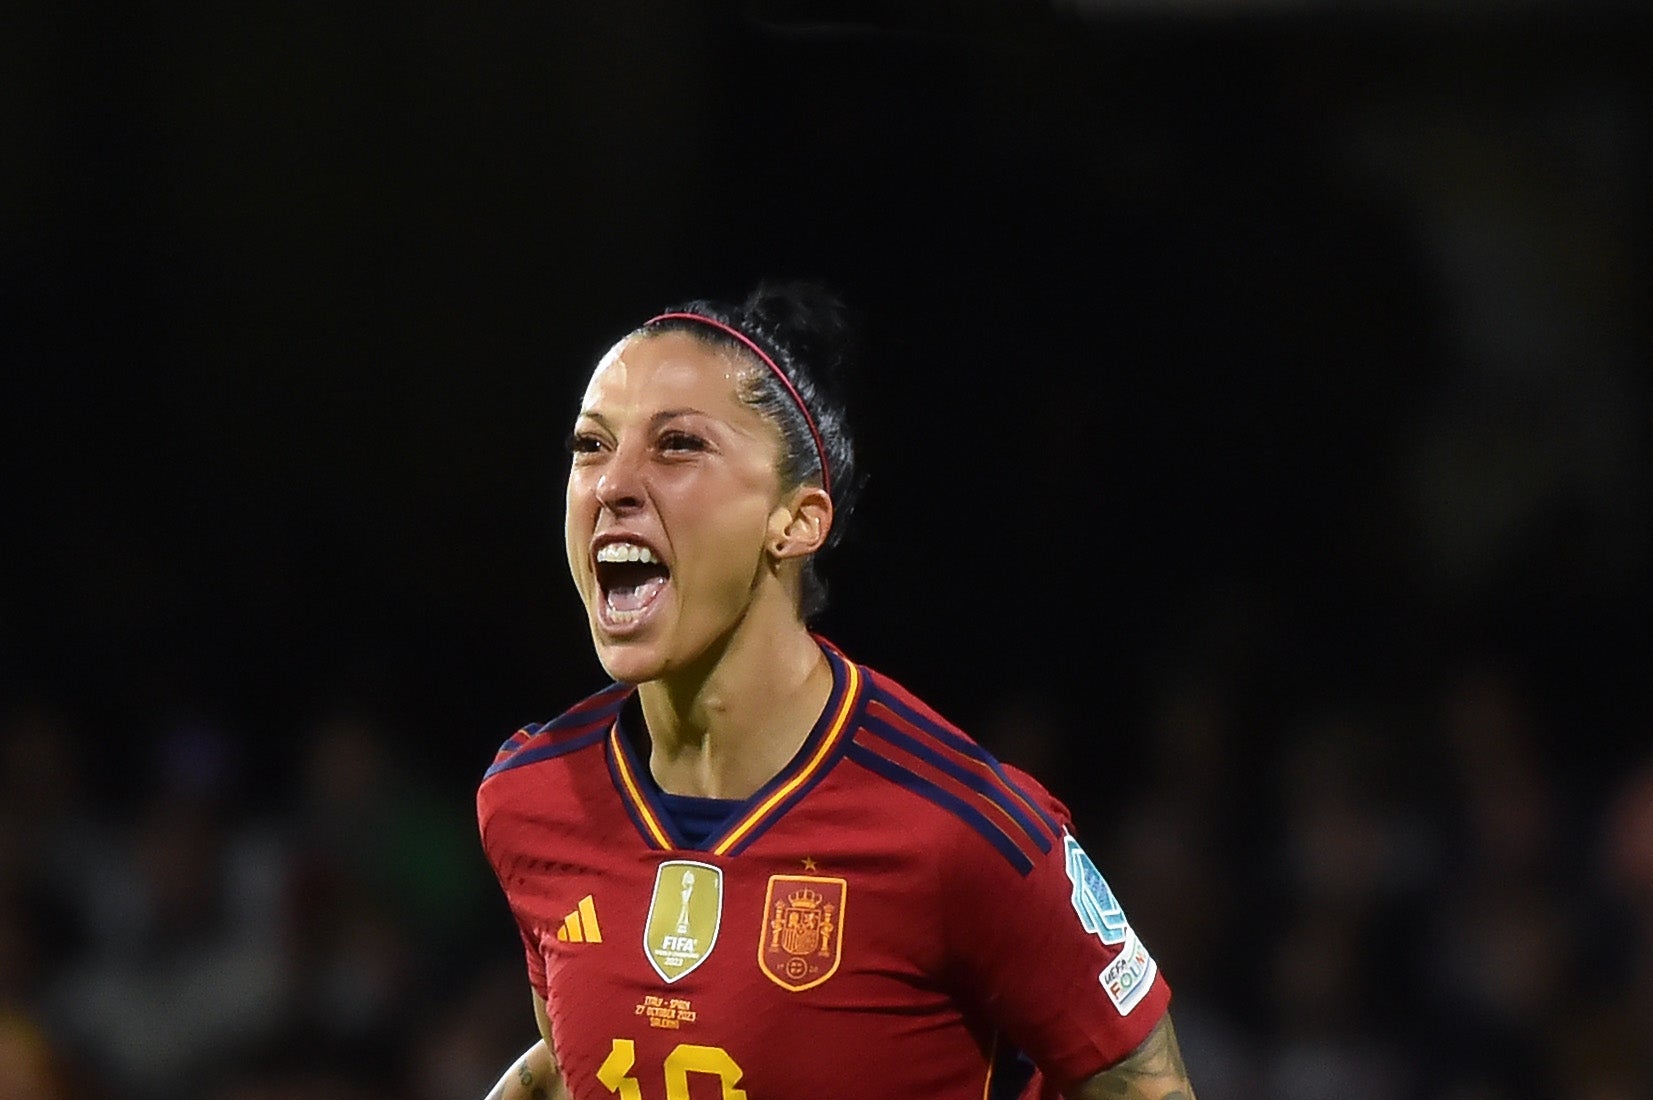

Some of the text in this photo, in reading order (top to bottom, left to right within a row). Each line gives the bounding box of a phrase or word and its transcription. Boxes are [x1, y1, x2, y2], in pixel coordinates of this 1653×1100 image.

[661, 935, 694, 953] FIFA
[1104, 958, 1127, 985] UEFA
[635, 1004, 645, 1015] 27
